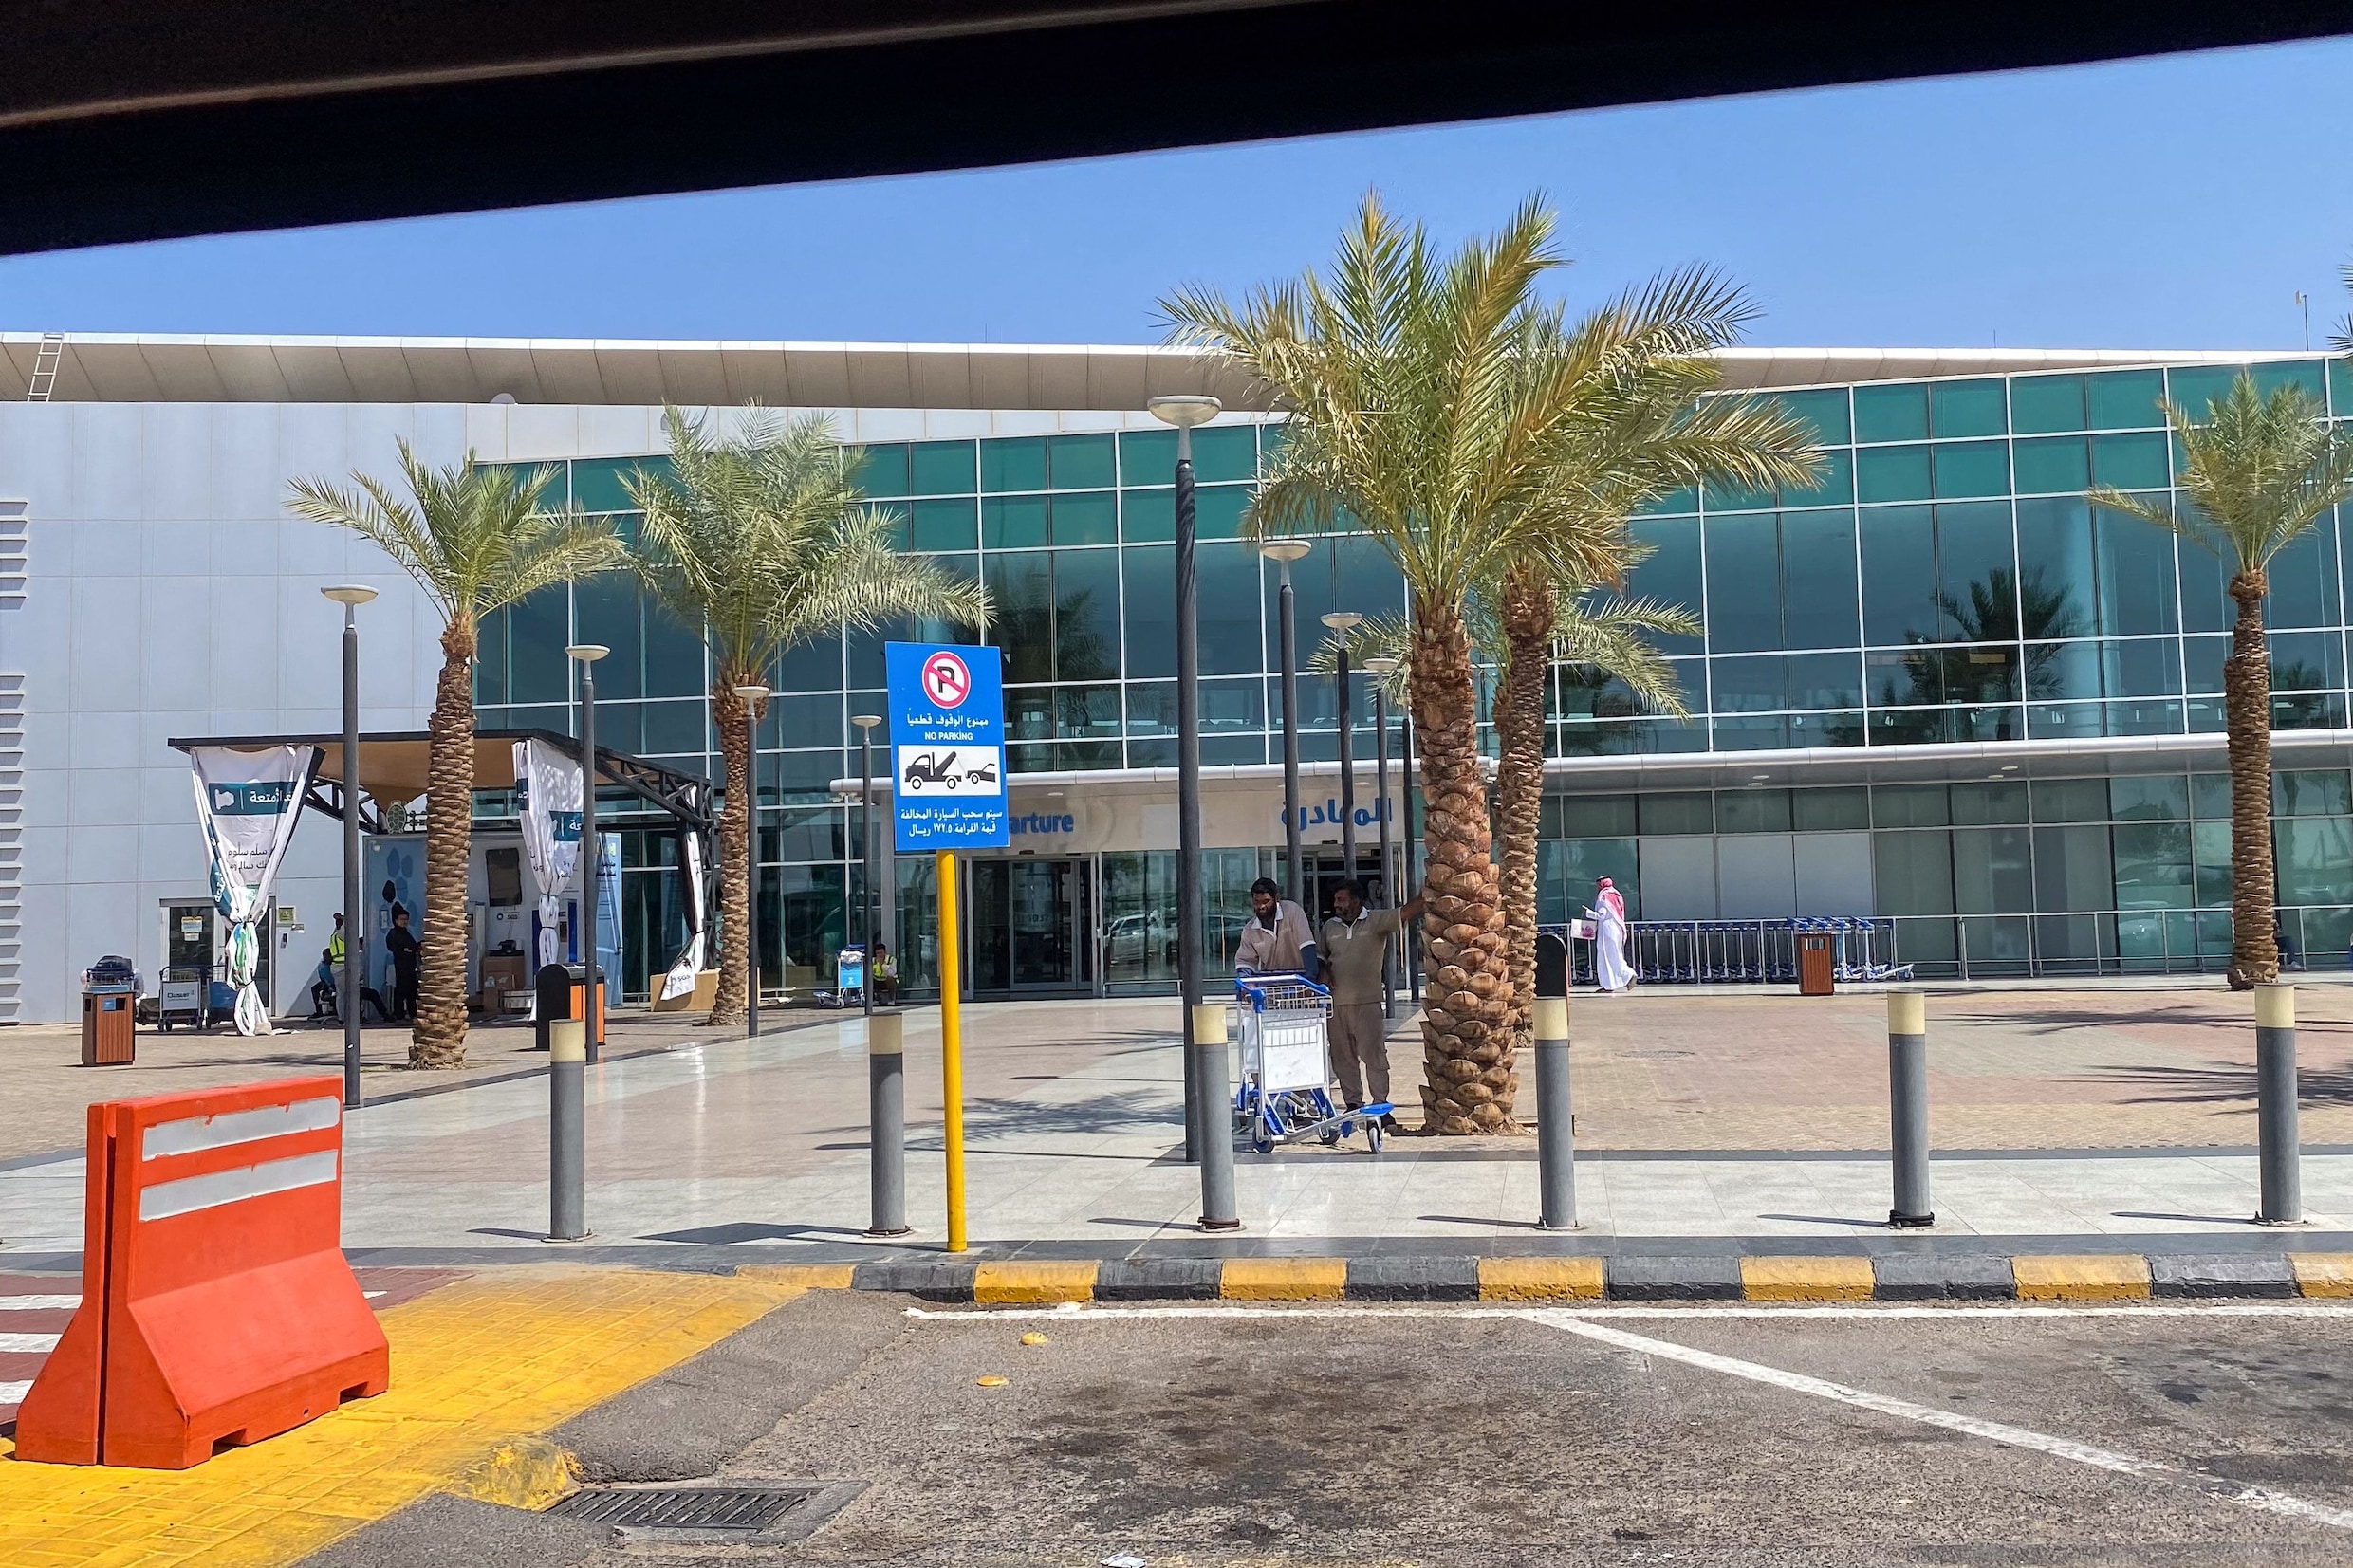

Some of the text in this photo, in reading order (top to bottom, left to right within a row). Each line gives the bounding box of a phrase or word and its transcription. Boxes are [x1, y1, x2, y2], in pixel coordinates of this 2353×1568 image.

[936, 713, 963, 729] الوقوف
[966, 716, 989, 729] ممنوع
[925, 731, 973, 741] NO PARKING
[900, 807, 1003, 821] سيتم سحب السيارة المخالفة
[1281, 797, 1393, 832] المادر
[908, 823, 931, 837] ريال
[954, 821, 979, 835] الغرامة
[981, 821, 996, 834] قيمة
[1009, 812, 1074, 834] arture
